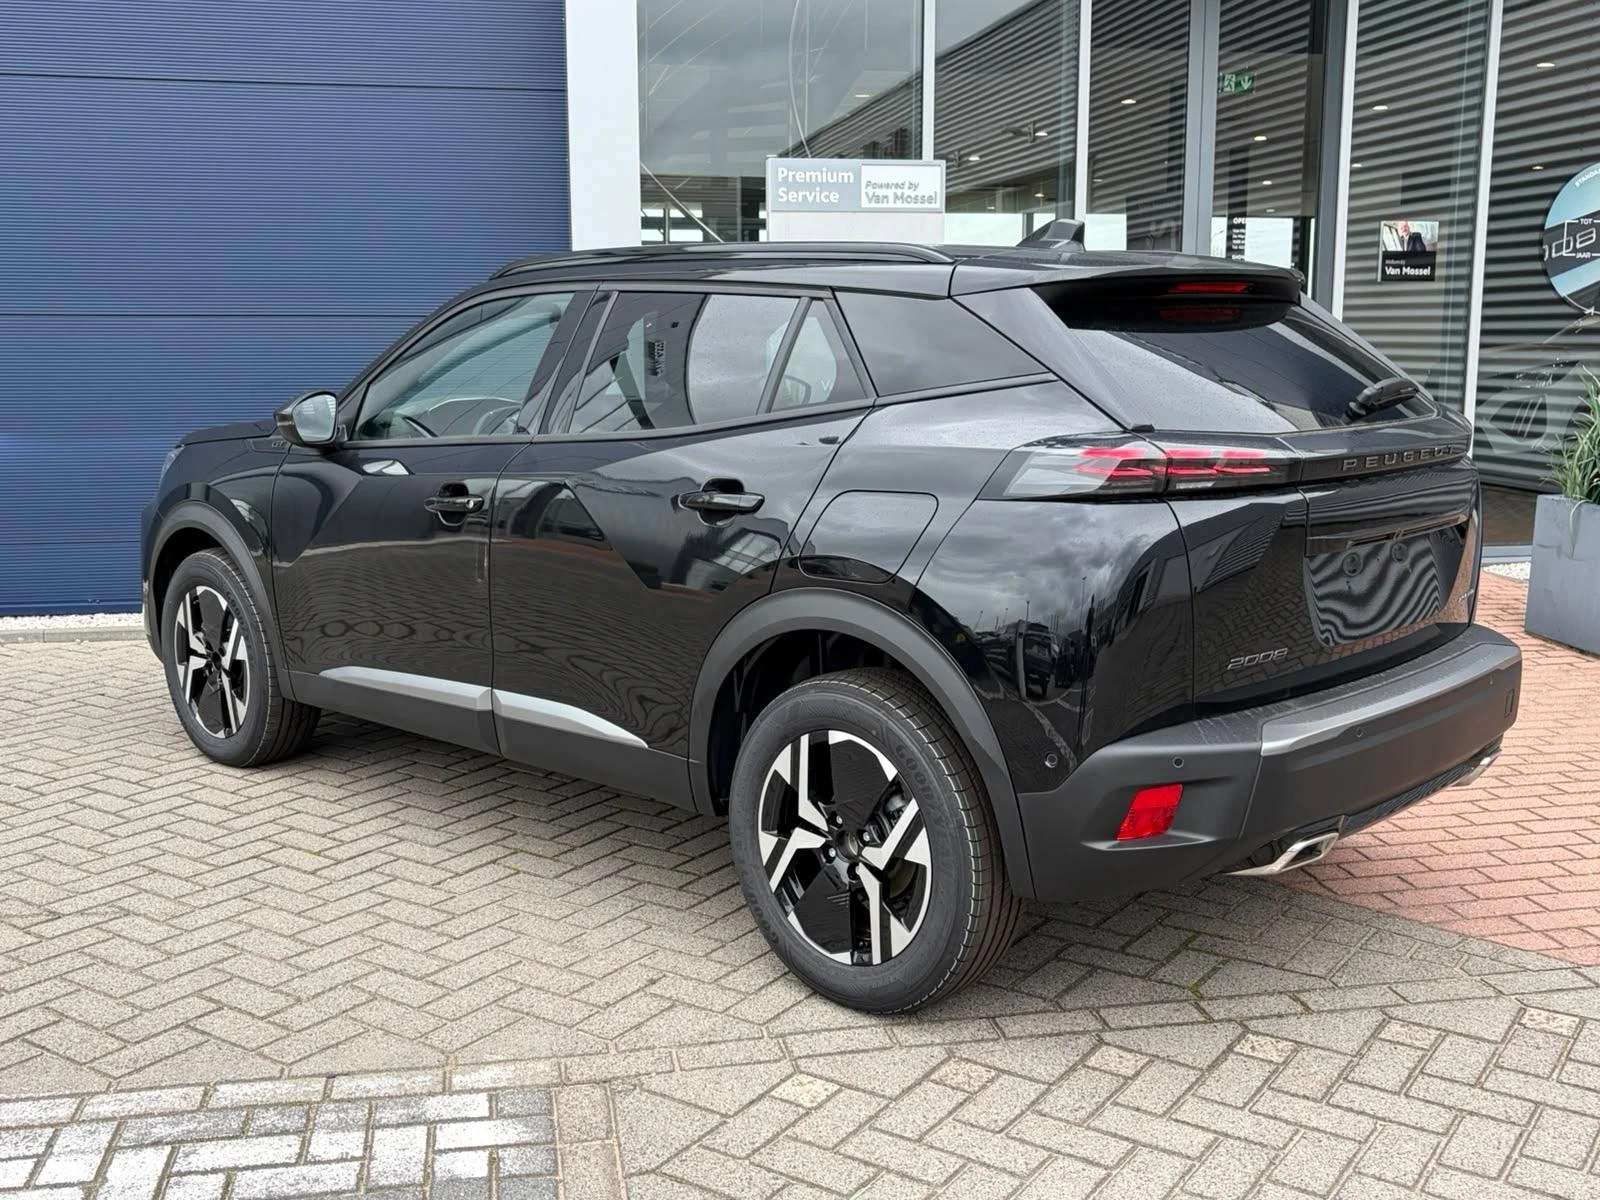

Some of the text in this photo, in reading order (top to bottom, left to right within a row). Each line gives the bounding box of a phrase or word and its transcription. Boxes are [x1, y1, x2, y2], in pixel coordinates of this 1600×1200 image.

[778, 167, 854, 183] Premium
[865, 180, 920, 192] Powered by
[778, 187, 840, 203] Service
[865, 191, 938, 205] Van Mossel
[1385, 266, 1431, 276] Van Mossel
[1227, 647, 1289, 671] 2008
